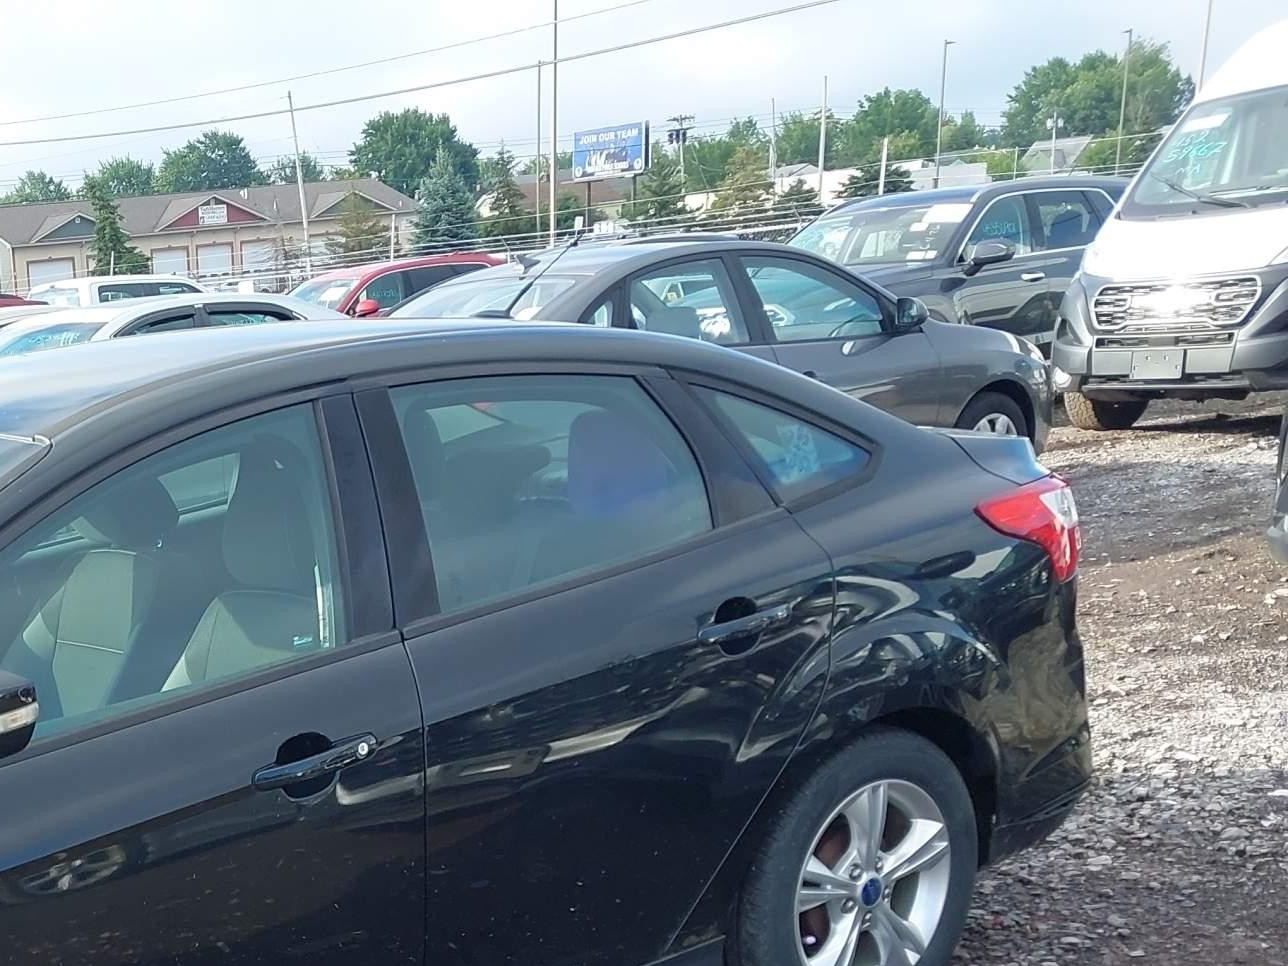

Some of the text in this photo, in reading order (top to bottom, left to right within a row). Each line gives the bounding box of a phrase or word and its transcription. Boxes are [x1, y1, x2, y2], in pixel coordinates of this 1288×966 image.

[579, 128, 638, 145] JOIN OUR TEAM
